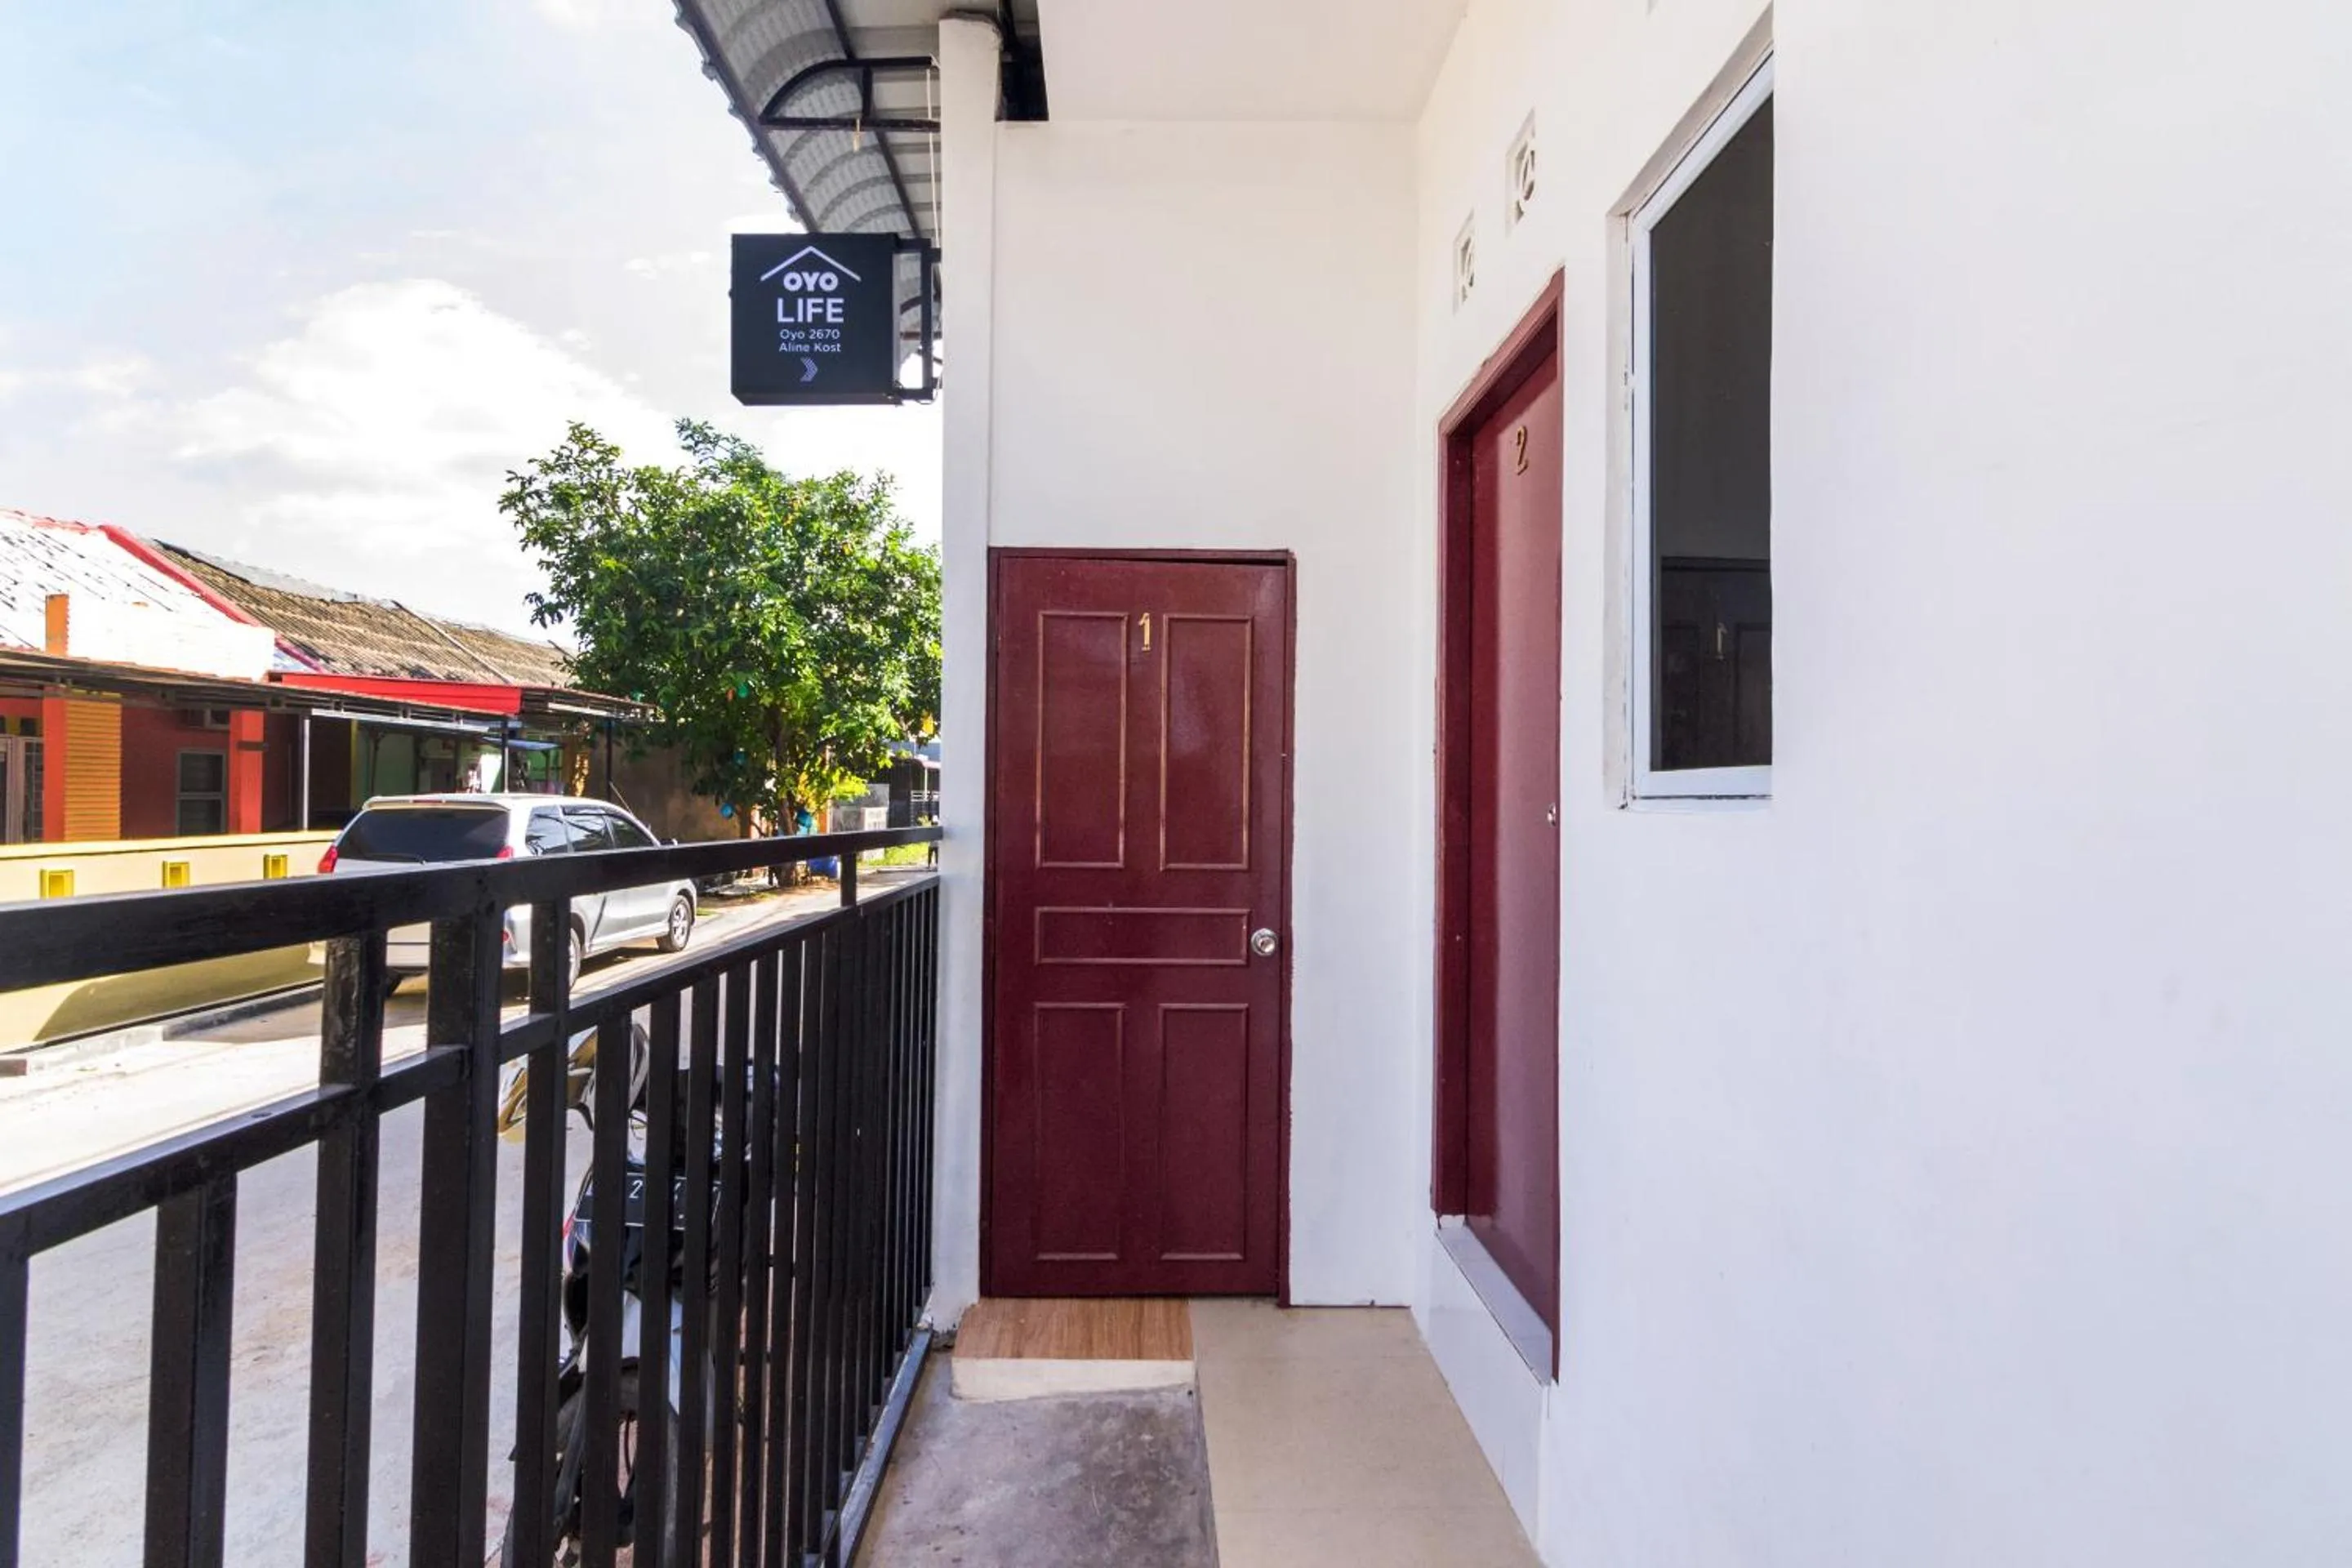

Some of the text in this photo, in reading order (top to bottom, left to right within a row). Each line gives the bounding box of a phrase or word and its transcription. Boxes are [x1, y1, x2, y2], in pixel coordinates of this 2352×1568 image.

[783, 272, 838, 292] OYO
[777, 297, 844, 323] LIFE
[779, 328, 840, 341] Oyo 2670
[778, 343, 842, 352] Aline Kost
[1138, 612, 1152, 653] 1
